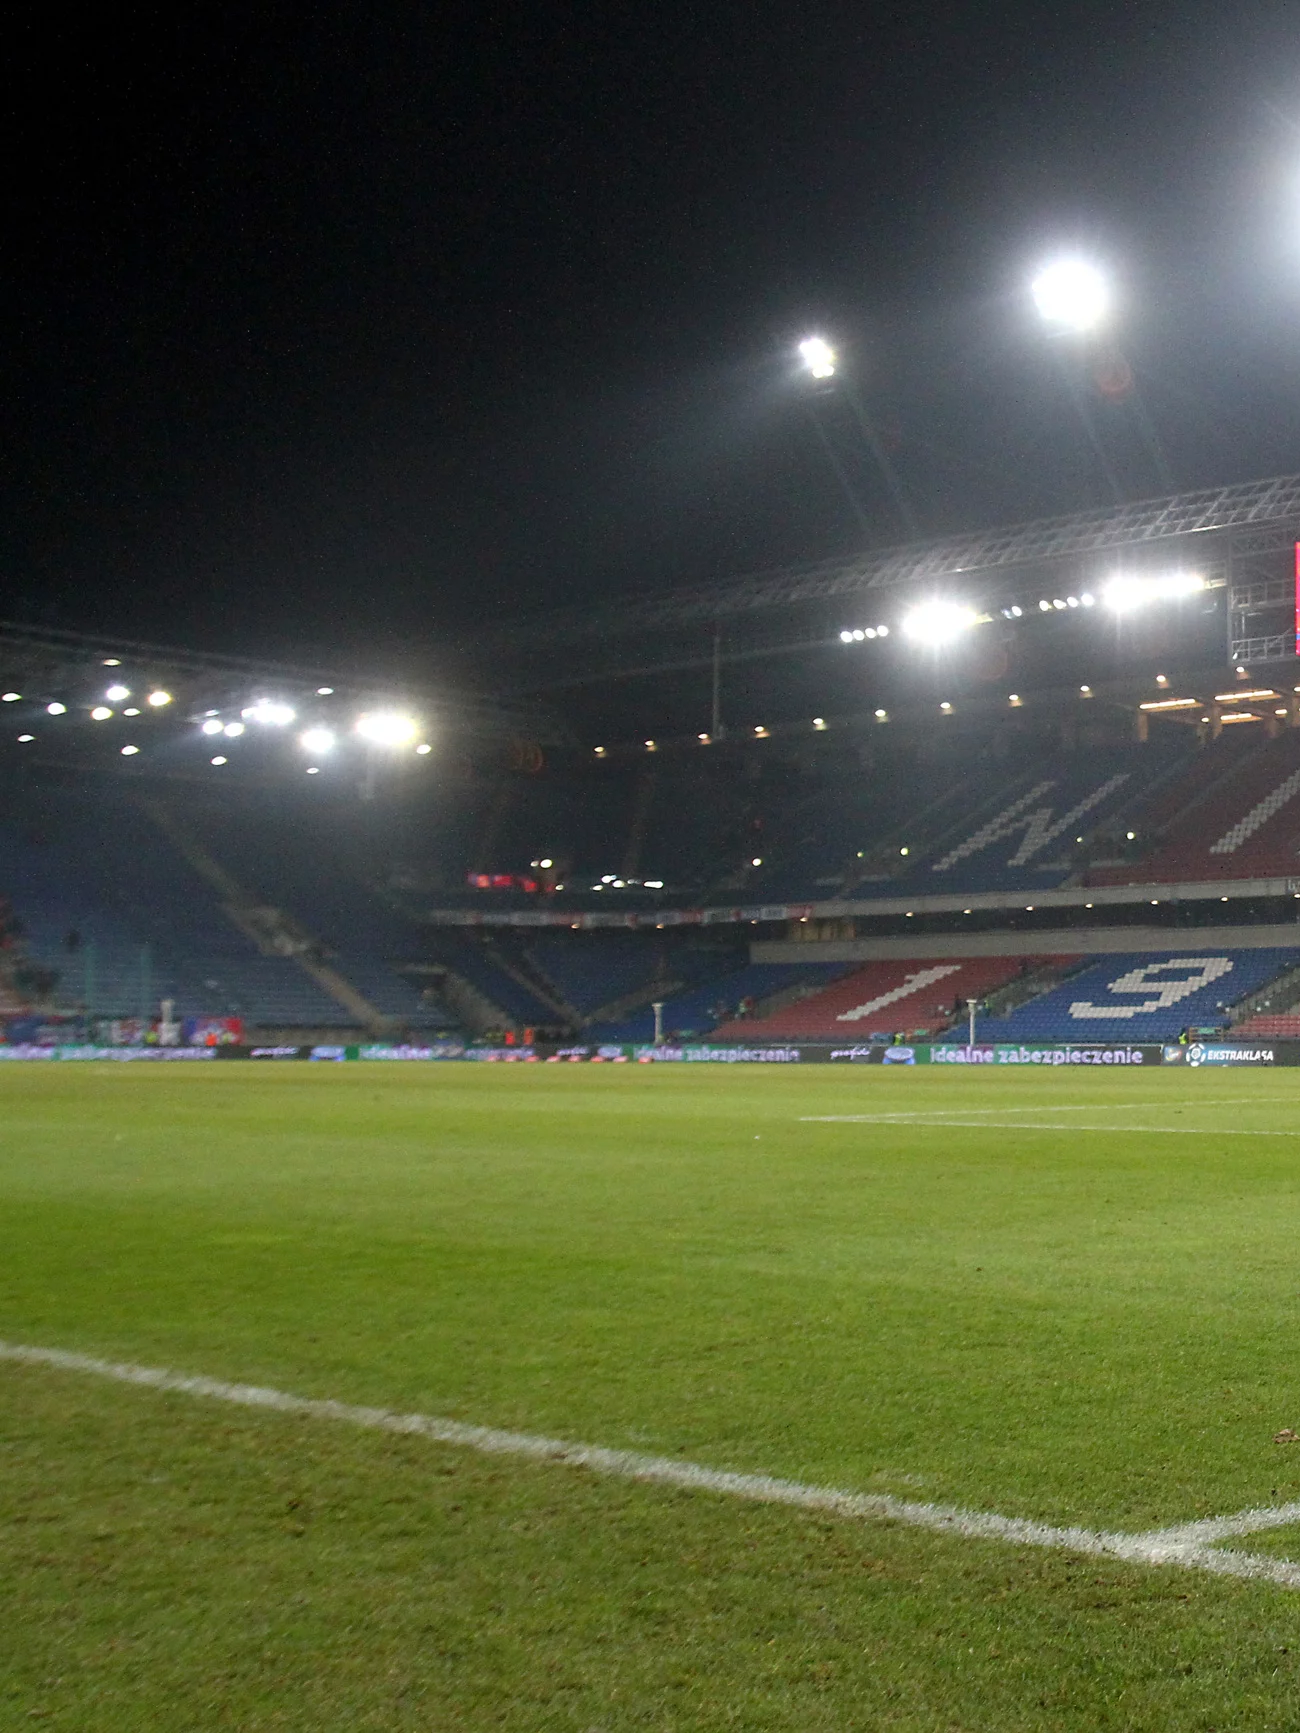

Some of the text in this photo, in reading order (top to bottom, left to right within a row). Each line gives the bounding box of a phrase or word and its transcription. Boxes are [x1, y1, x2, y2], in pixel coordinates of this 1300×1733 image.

[930, 1046, 993, 1064] Idealne
[998, 1046, 1142, 1066] zabezpieczenie
[1207, 1050, 1273, 1061] EKSTRAKLASA
